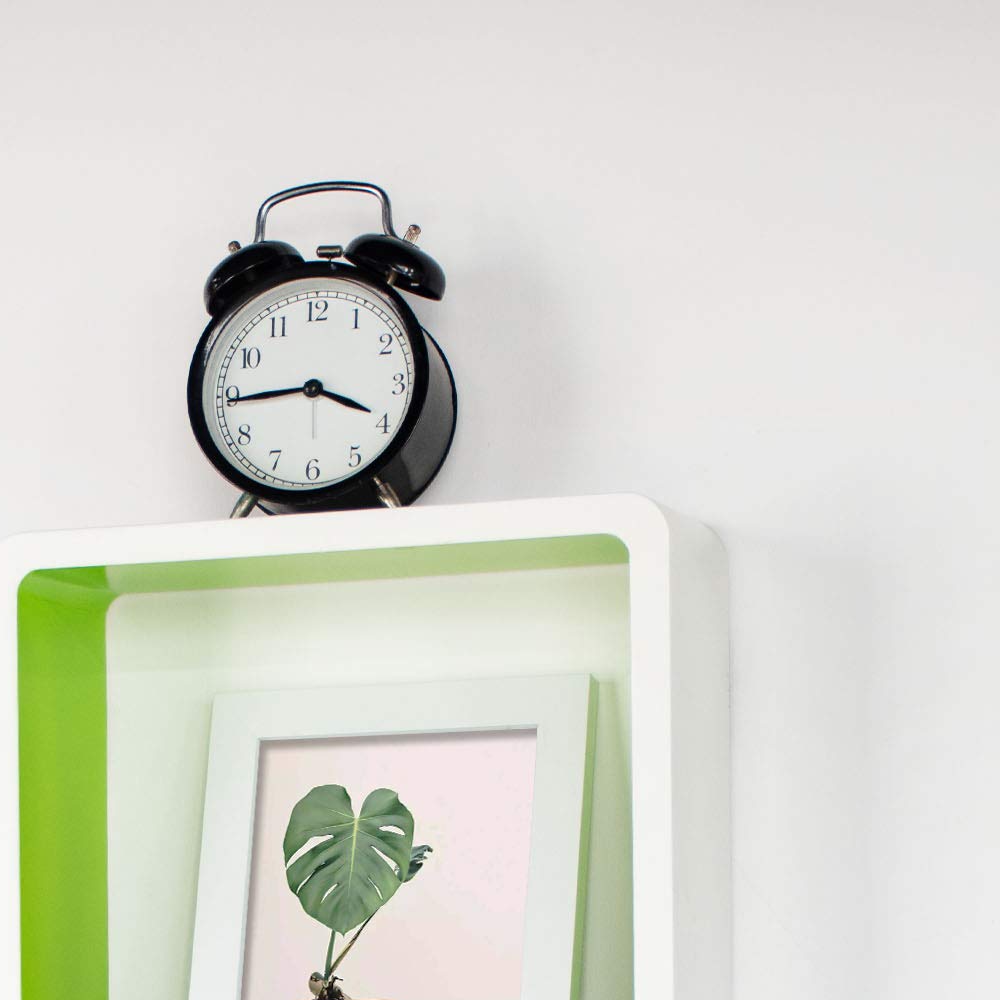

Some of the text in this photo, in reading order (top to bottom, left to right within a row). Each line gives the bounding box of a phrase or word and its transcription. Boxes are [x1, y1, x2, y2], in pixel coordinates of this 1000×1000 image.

[307, 299, 329, 322] 12
[351, 307, 360, 330] 1
[269, 315, 287, 338] 11
[379, 333, 393, 355] 2
[240, 347, 261, 369] 10
[391, 373, 406, 395] 3
[225, 385, 240, 407] 9
[375, 412, 391, 434] 4
[237, 424, 252, 446] 8
[268, 449, 282, 472] 7
[348, 445, 362, 468] 5
[305, 458, 321, 481] 6
